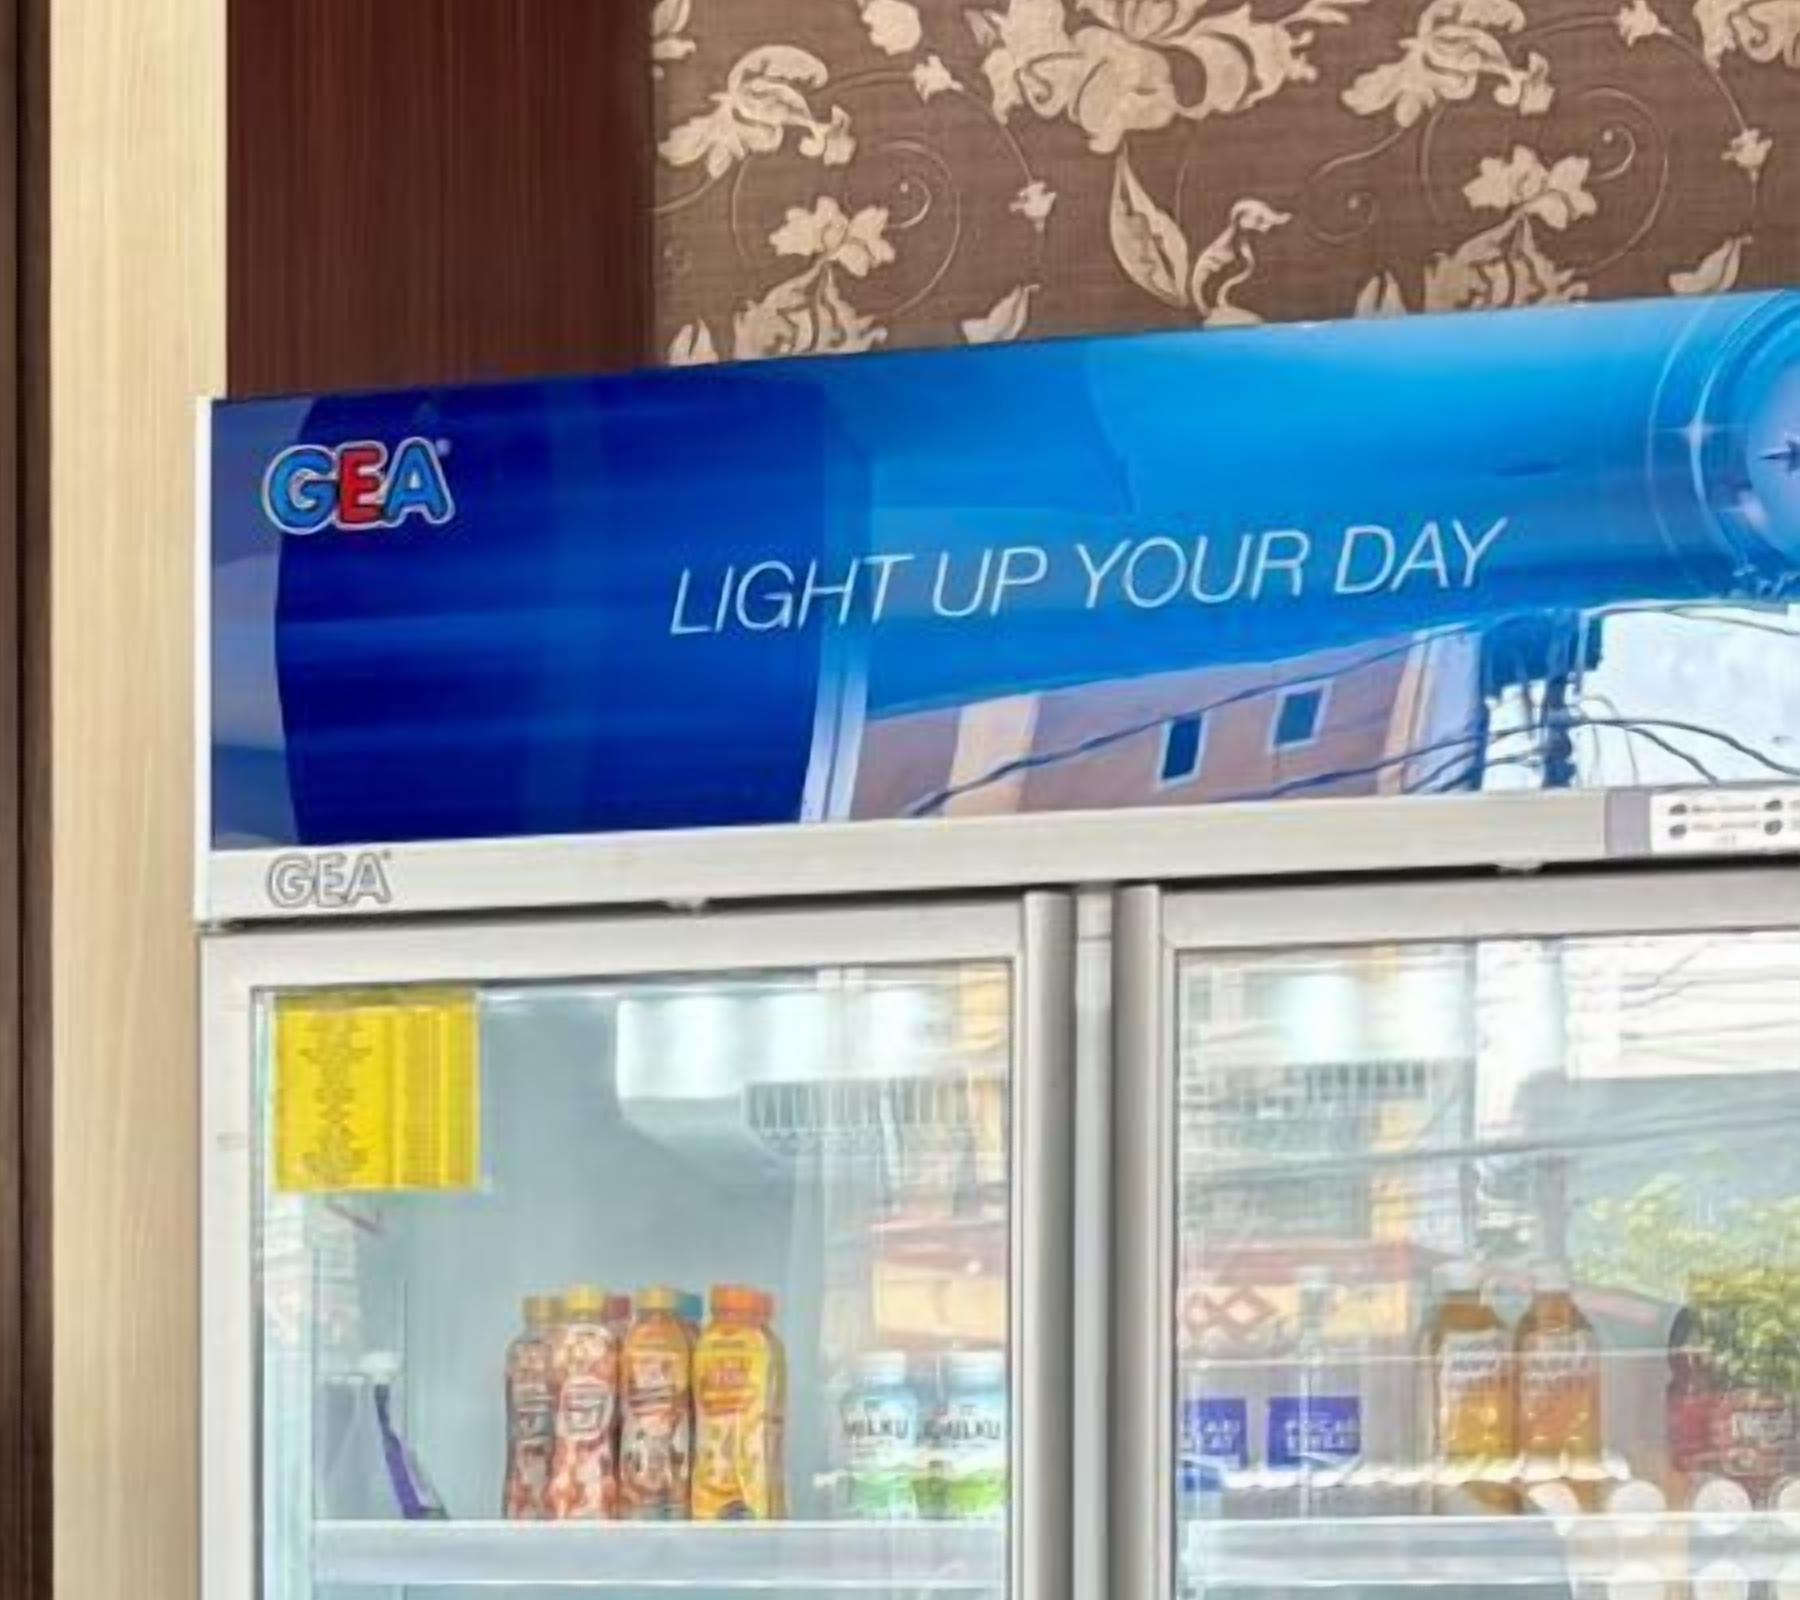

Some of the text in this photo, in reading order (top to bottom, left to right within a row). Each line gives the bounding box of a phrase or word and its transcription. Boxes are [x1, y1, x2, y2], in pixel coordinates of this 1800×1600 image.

[262, 436, 455, 535] GEA
[670, 516, 1509, 636] LIGHT UP YOUR DAY
[266, 851, 393, 909] GEA
